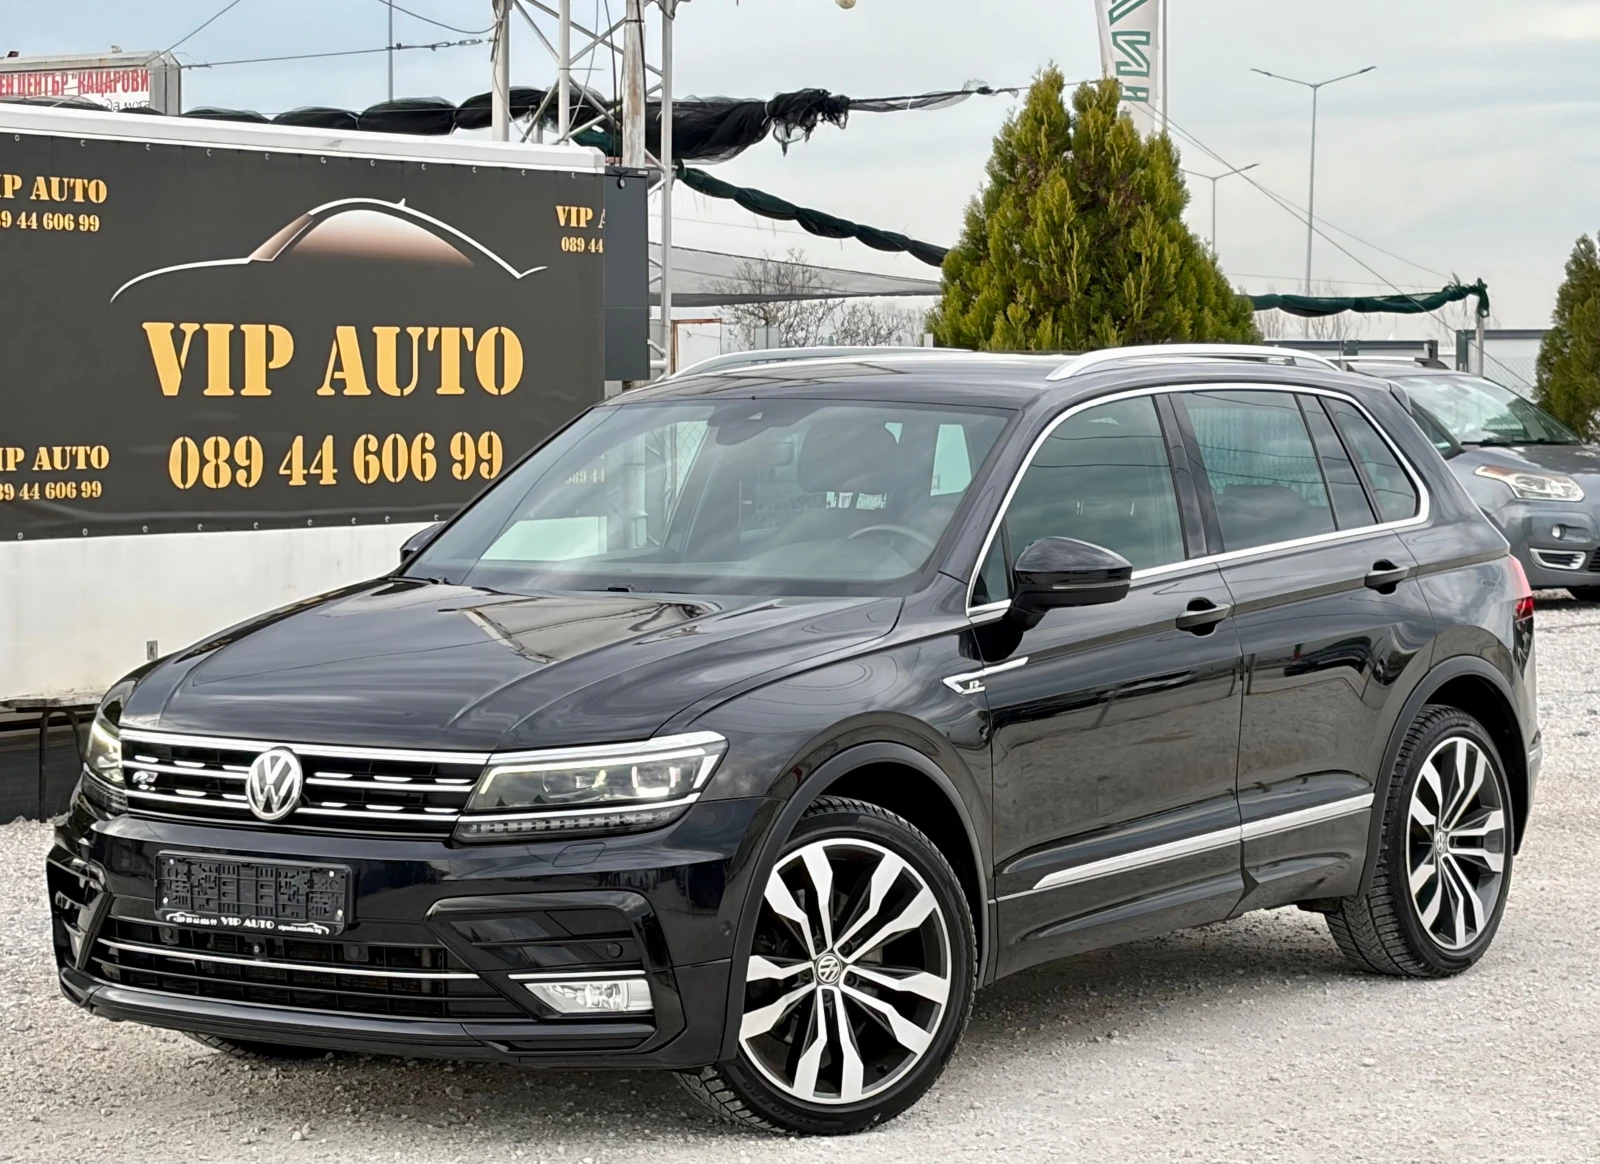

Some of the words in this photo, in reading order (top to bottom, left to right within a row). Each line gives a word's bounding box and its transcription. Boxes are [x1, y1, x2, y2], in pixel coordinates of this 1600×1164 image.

[17, 72, 69, 100] ЦЕНТЪР
[29, 175, 108, 204] AUTO
[16, 211, 38, 230] 44
[42, 212, 75, 231] 606
[78, 214, 100, 232] 99
[555, 205, 594, 228] VIP
[561, 236, 585, 252] 089
[587, 237, 604, 253] 44
[142, 321, 295, 397] VIP
[316, 325, 524, 397] AUTO
[31, 445, 110, 471] AUTO
[168, 435, 264, 490] 089
[278, 434, 339, 486] 44
[352, 432, 438, 484] 606
[449, 430, 504, 481] 99
[18, 482, 41, 501] 44
[44, 481, 77, 500] 606
[80, 480, 103, 499] 99
[220, 916, 241, 926] VIP
[243, 918, 275, 929] AUTO
